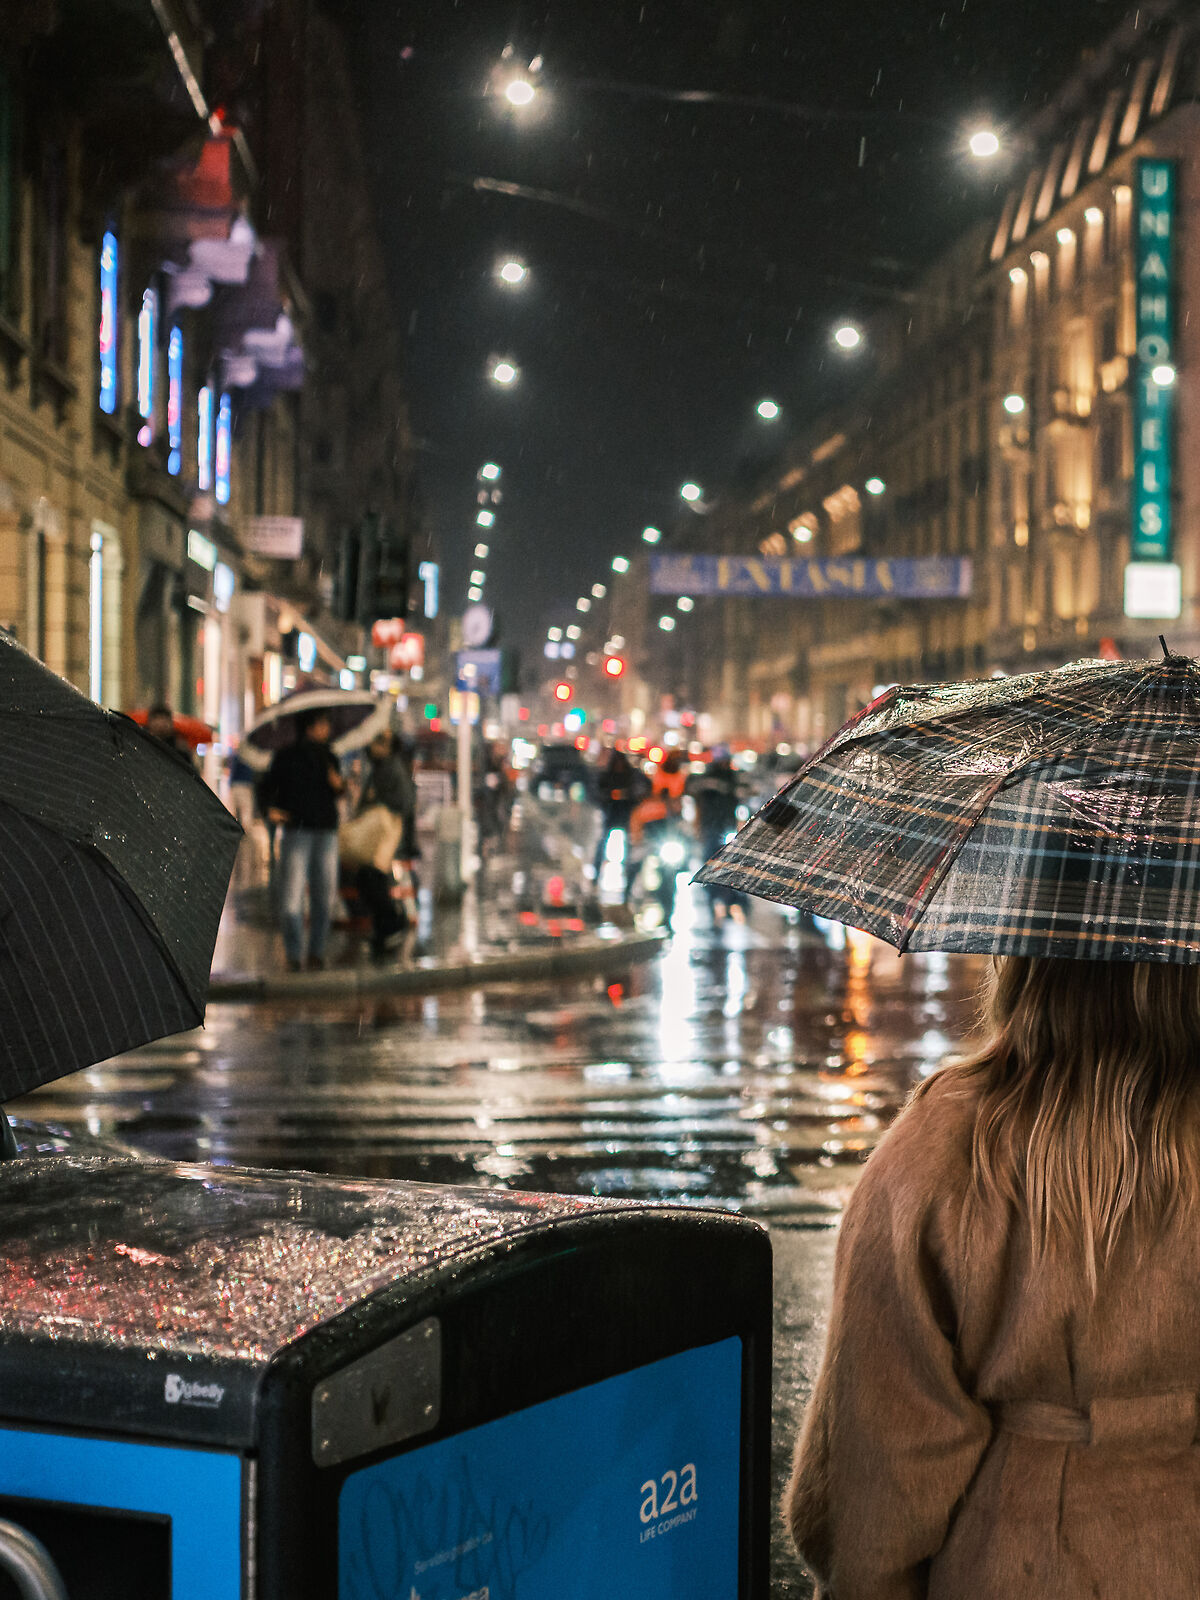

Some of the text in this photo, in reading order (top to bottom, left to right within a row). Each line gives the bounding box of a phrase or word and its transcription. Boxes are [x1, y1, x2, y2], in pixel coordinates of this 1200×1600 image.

[1138, 167, 1169, 536] UNAHOTELS
[640, 1463, 698, 1523] a2a
[640, 1507, 697, 1543] LIFE COMPANY
